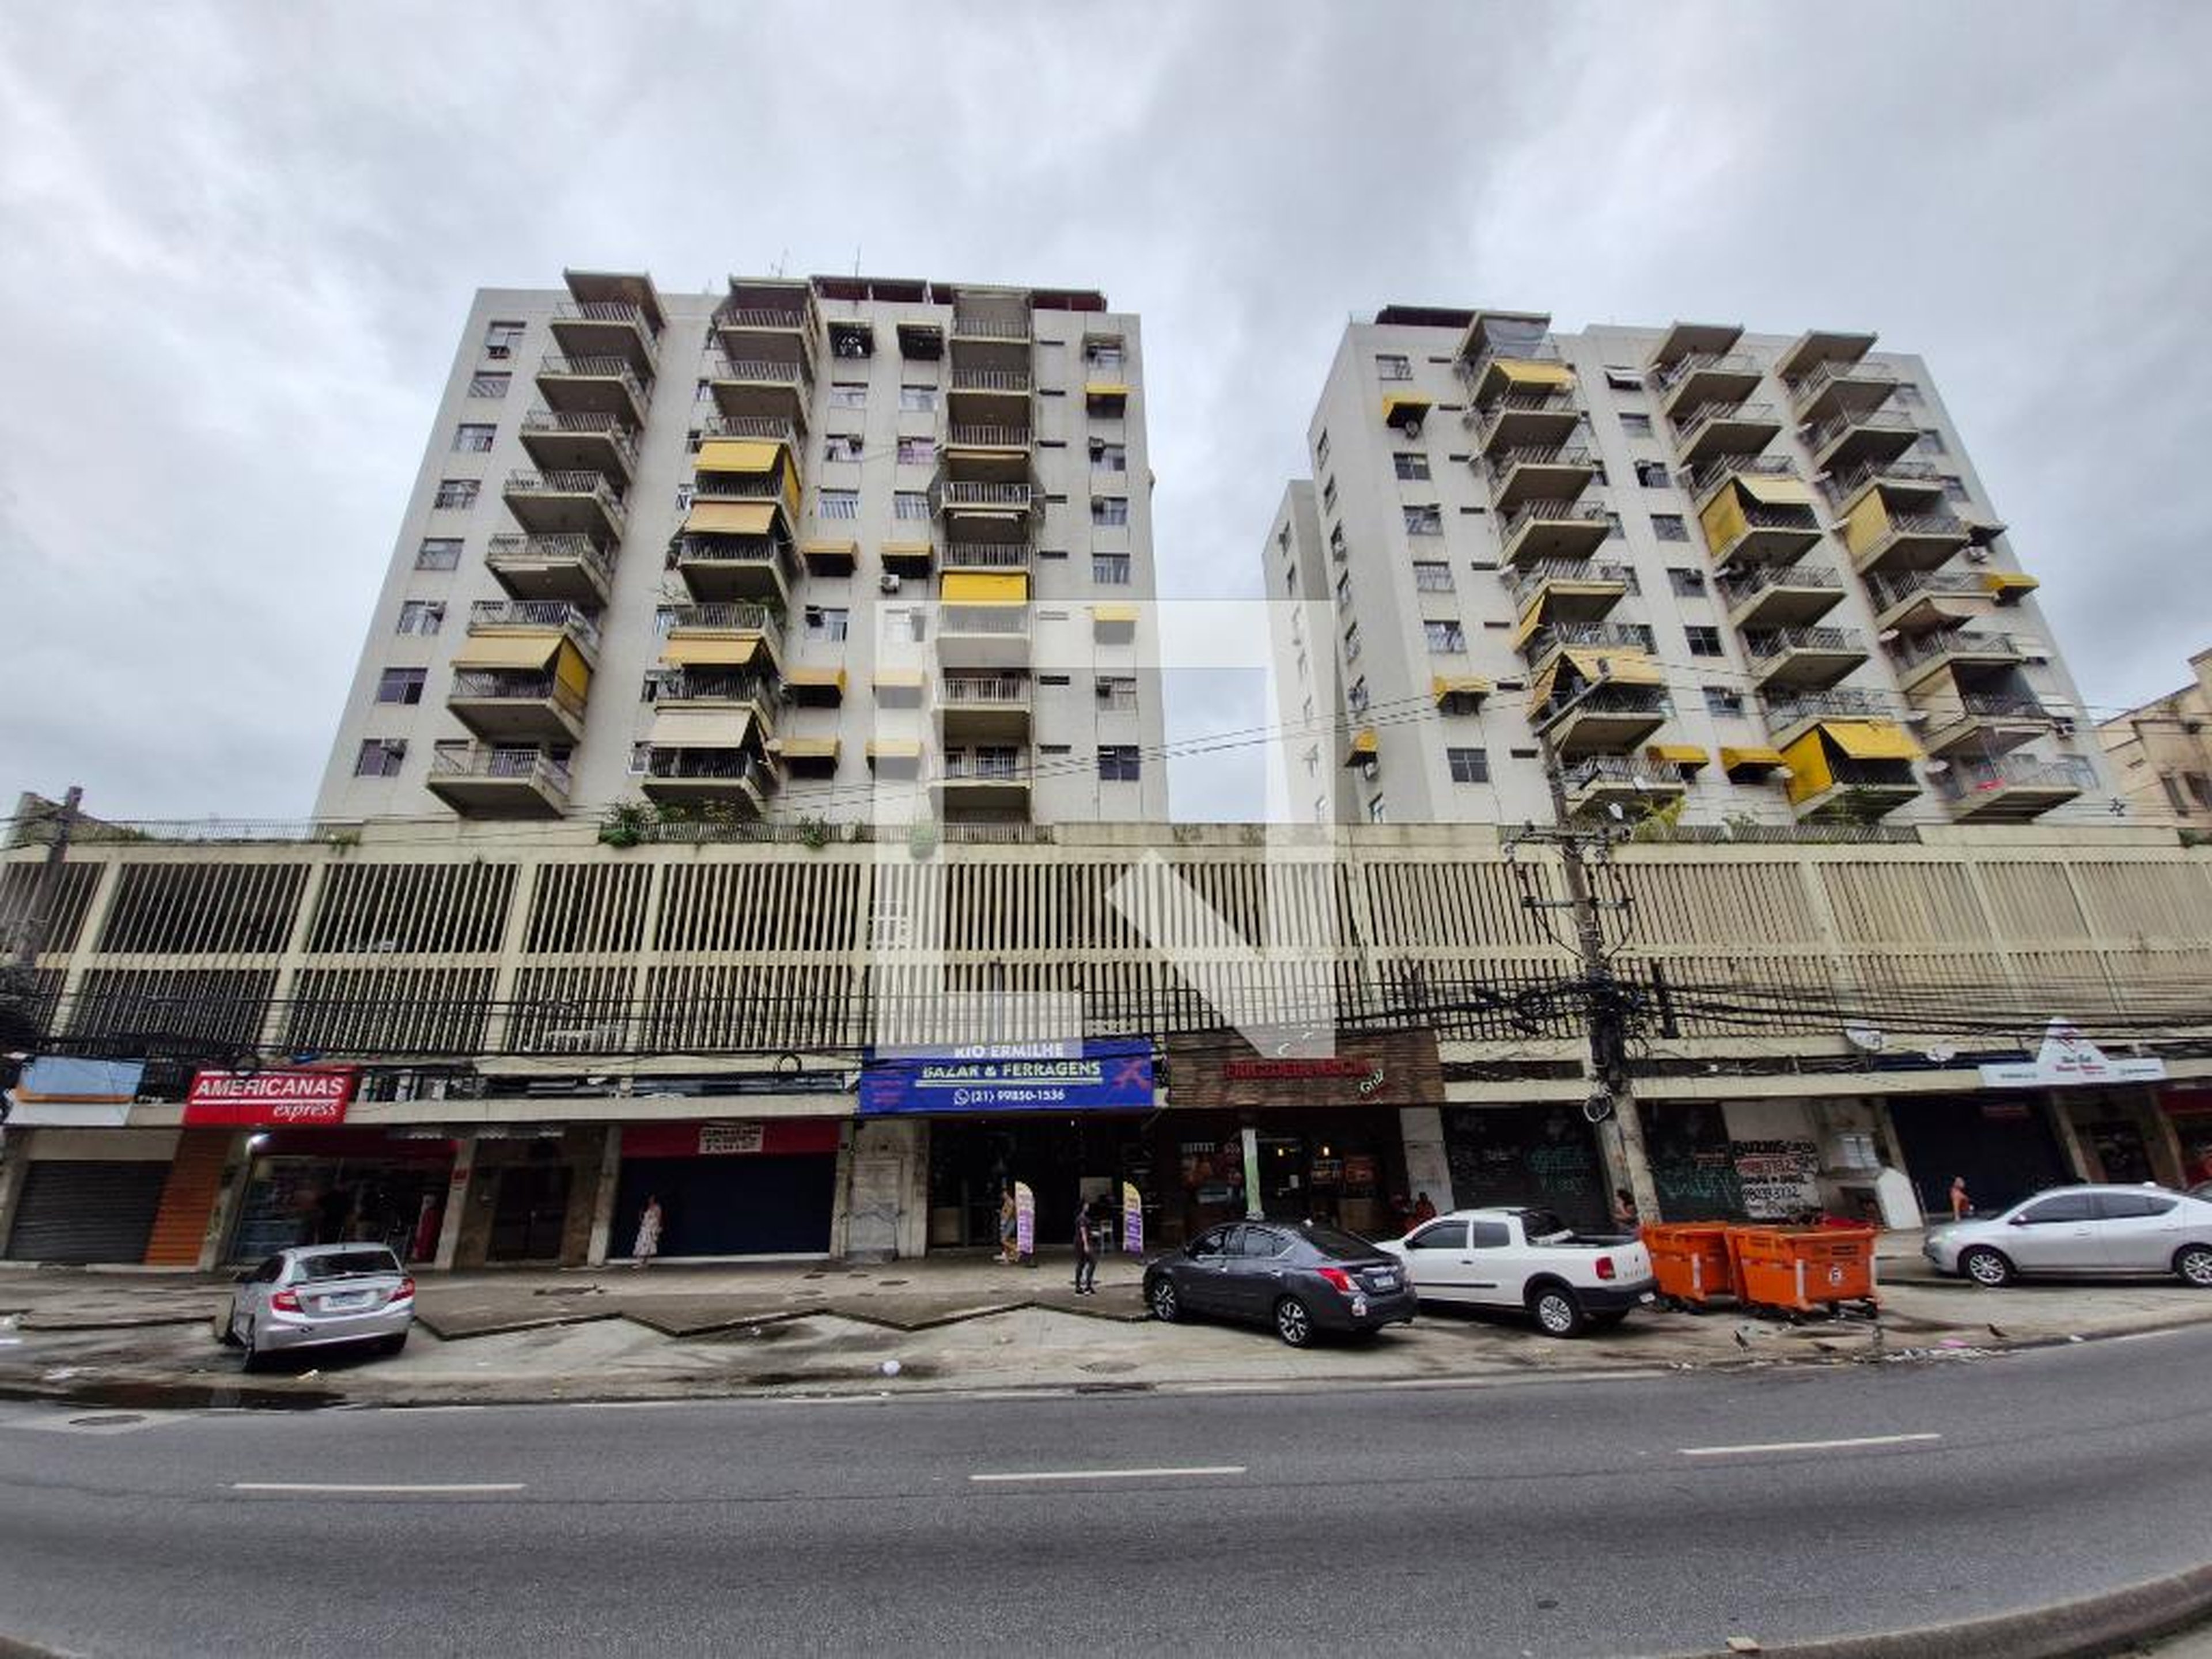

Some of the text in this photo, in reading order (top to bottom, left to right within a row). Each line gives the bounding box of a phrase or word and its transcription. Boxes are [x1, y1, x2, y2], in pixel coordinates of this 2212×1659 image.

[922, 1061, 1101, 1078] BAZAR & FERRAGENS
[194, 1077, 344, 1096] AMERICANAS
[273, 1103, 338, 1121] express
